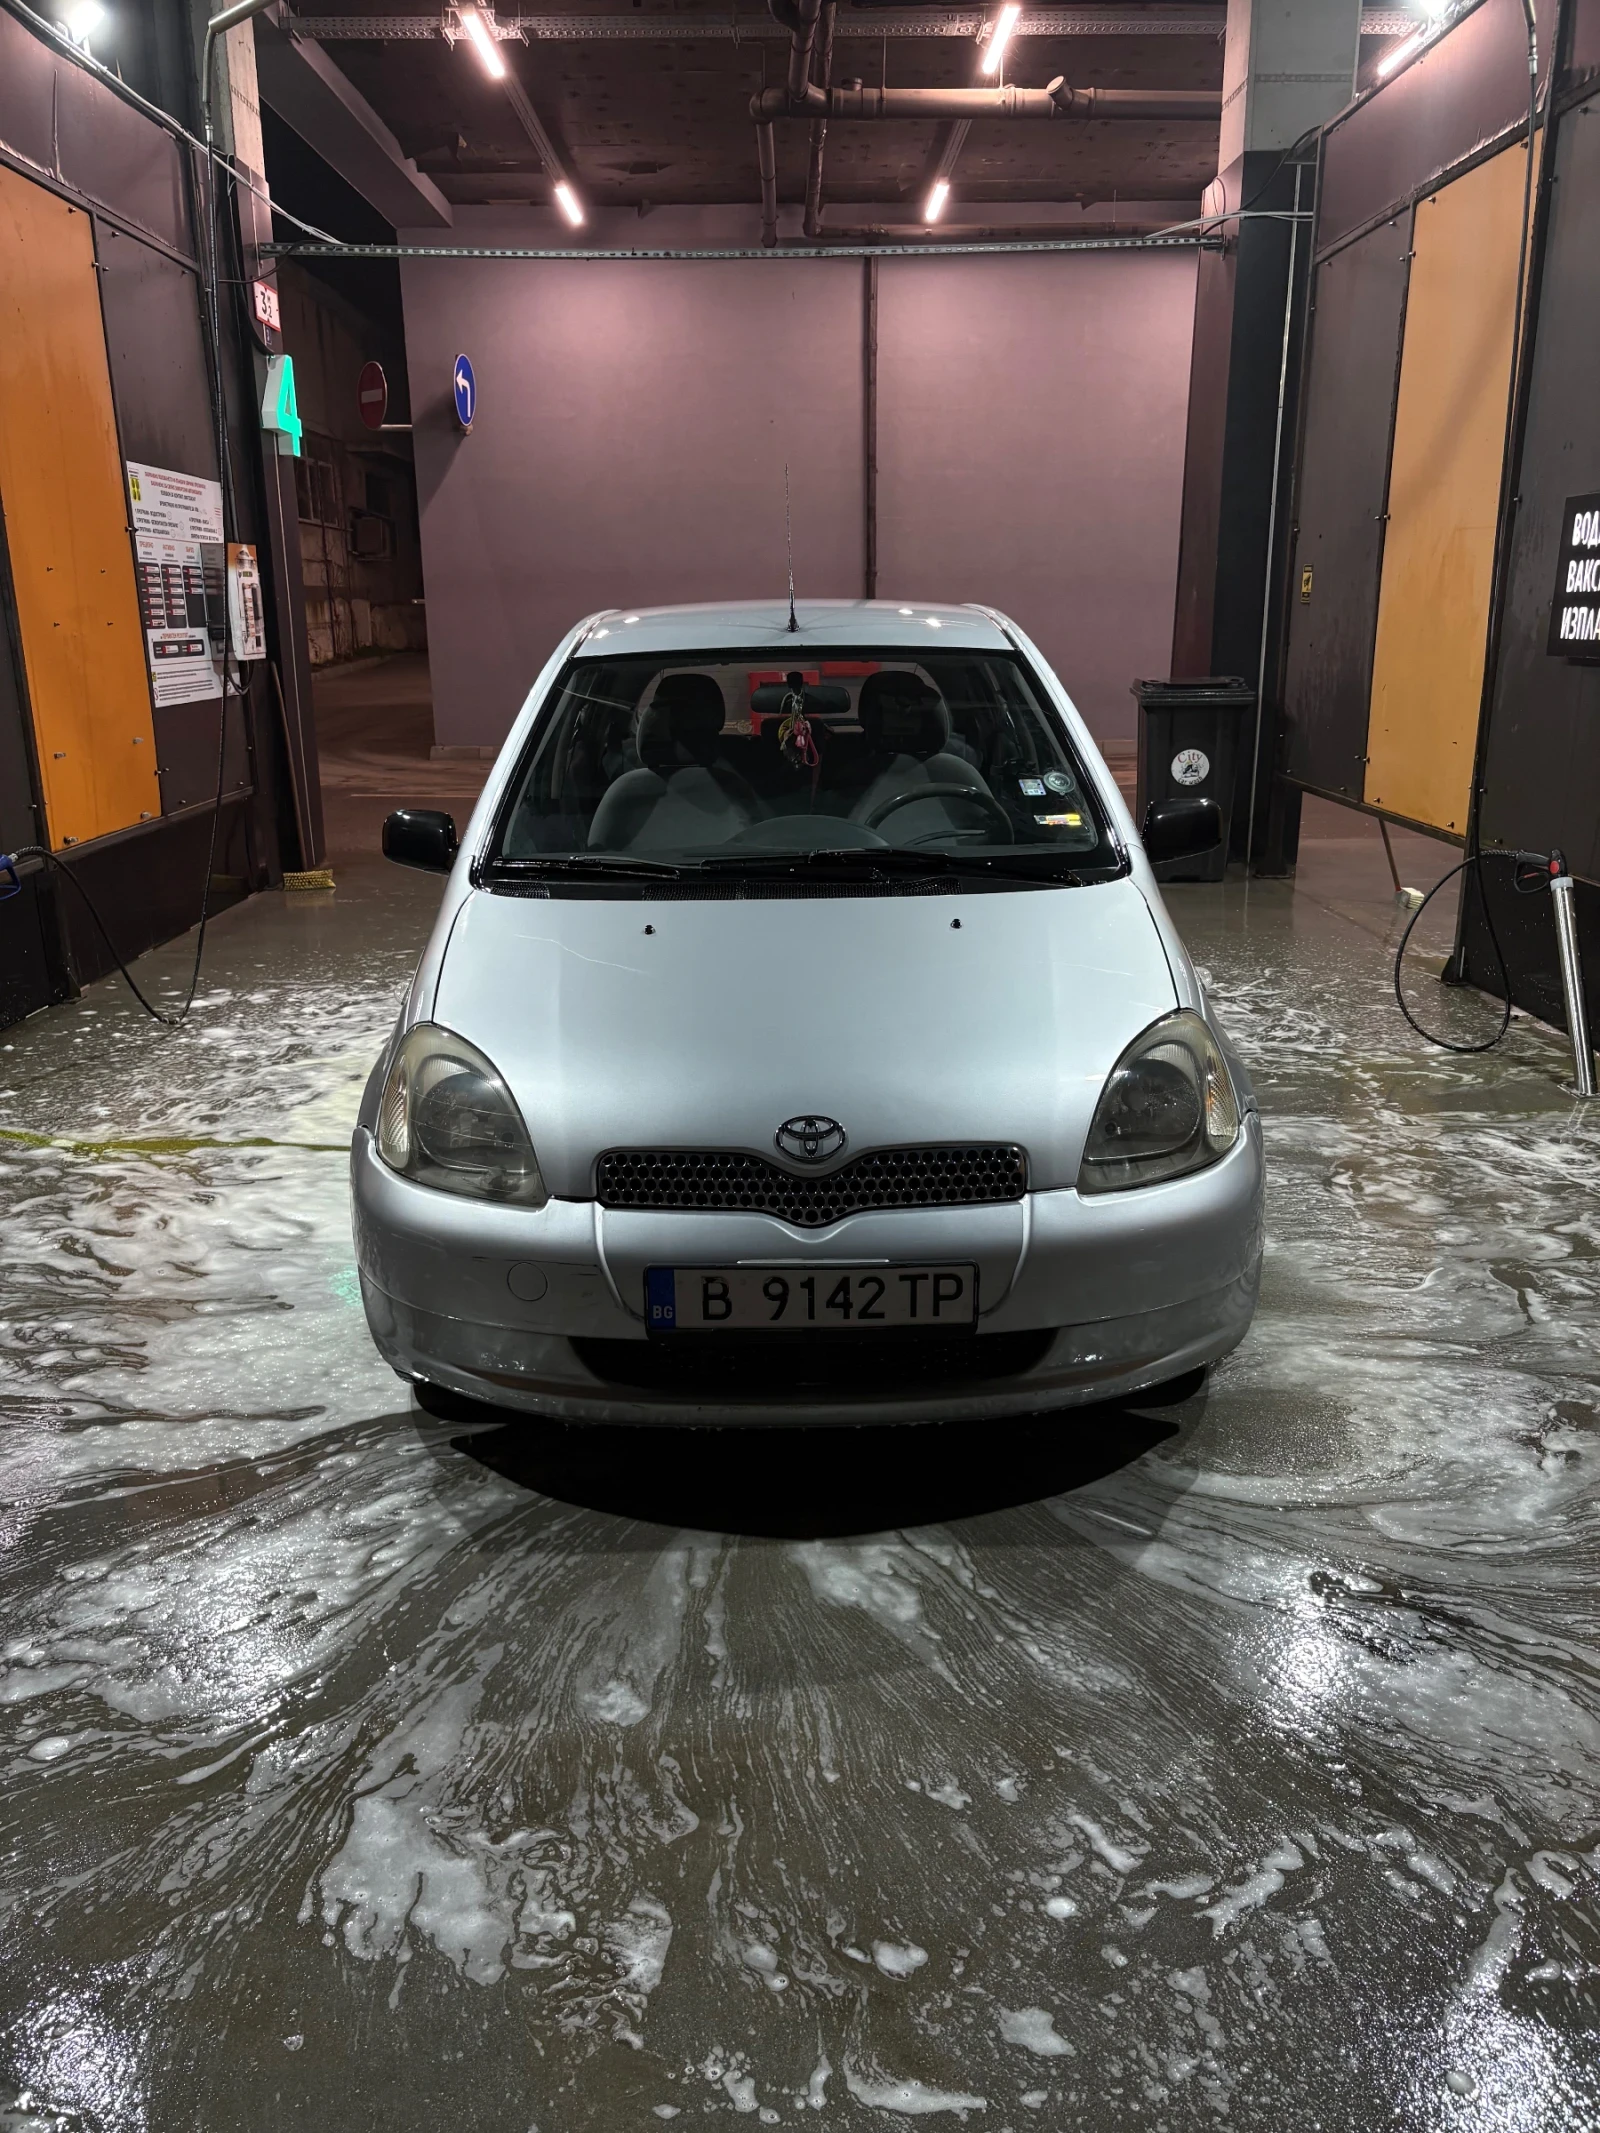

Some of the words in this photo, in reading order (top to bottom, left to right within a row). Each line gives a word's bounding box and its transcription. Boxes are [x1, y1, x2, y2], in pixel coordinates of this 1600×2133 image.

[275, 354, 303, 457] 4
[1571, 510, 1600, 549] ВОД
[1566, 559, 1600, 593] ВАКС
[1178, 751, 1203, 764] City
[652, 1304, 674, 1320] BG
[702, 1276, 733, 1321] B
[763, 1276, 886, 1321] 9142
[899, 1273, 963, 1317] TP
